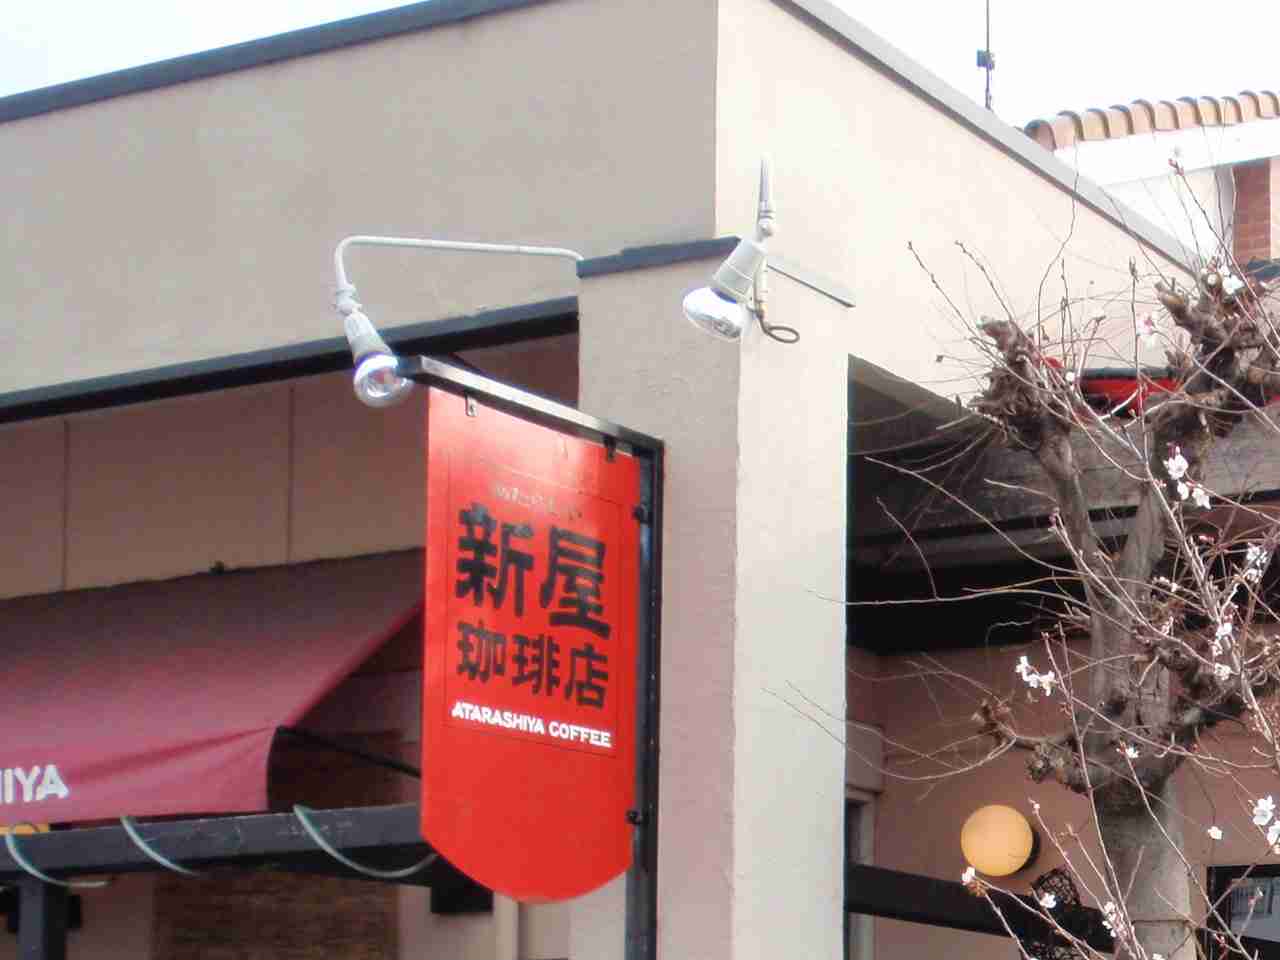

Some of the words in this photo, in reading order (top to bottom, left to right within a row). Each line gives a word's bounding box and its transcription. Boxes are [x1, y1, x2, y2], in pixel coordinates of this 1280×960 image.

[454, 502, 611, 640] 新屋
[457, 620, 609, 710] 珈琲店
[451, 701, 545, 735] ATARASHIYA
[548, 721, 612, 748] COFFEE
[0, 764, 69, 804] IYA
